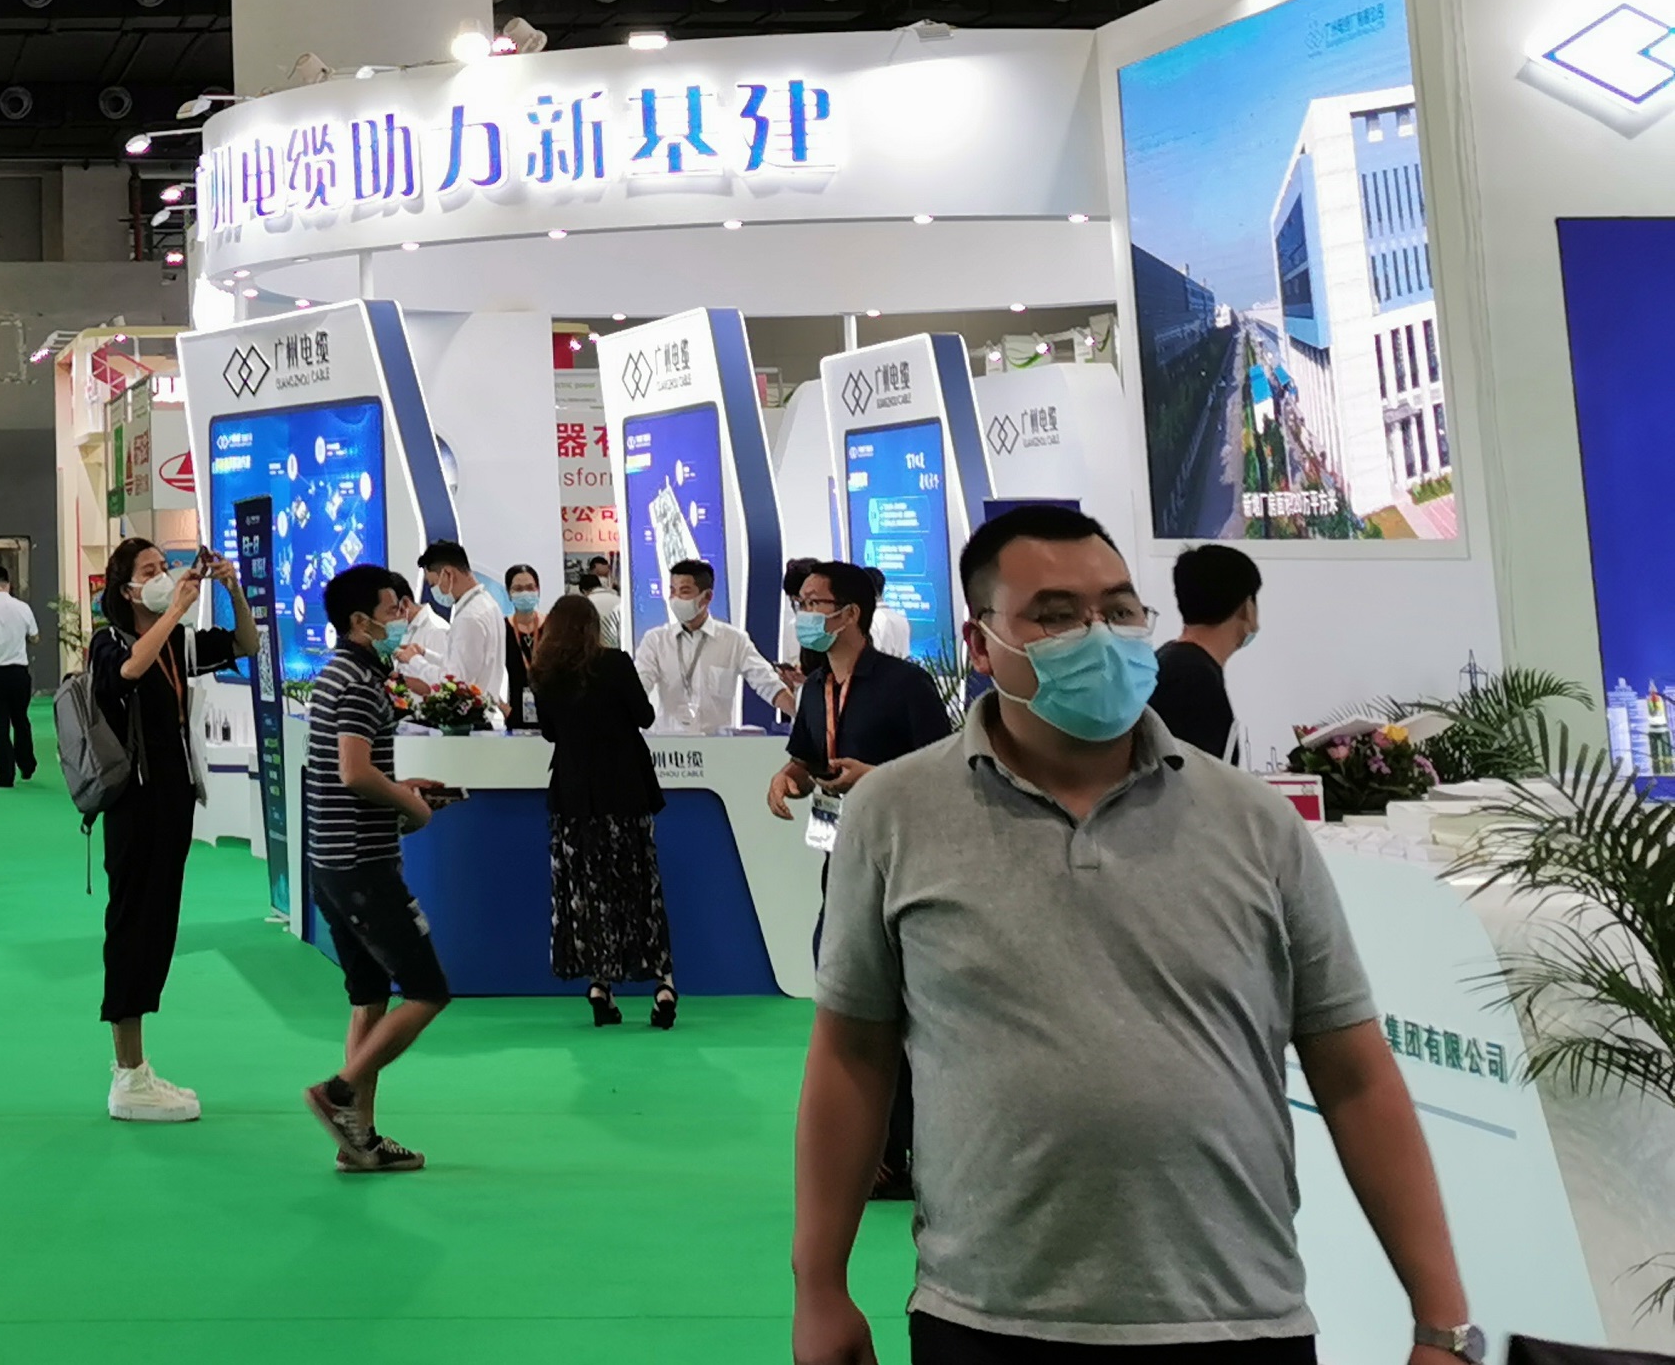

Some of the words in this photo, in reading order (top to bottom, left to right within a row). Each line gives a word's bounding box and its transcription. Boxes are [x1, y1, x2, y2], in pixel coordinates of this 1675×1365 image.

[274, 330, 330, 372] 广州电缆
[654, 338, 691, 376] 广州电缆
[875, 360, 911, 395] 广州电缆
[1021, 405, 1059, 435] 广州电缆
[1384, 1012, 1508, 1085] 集团有限公司
